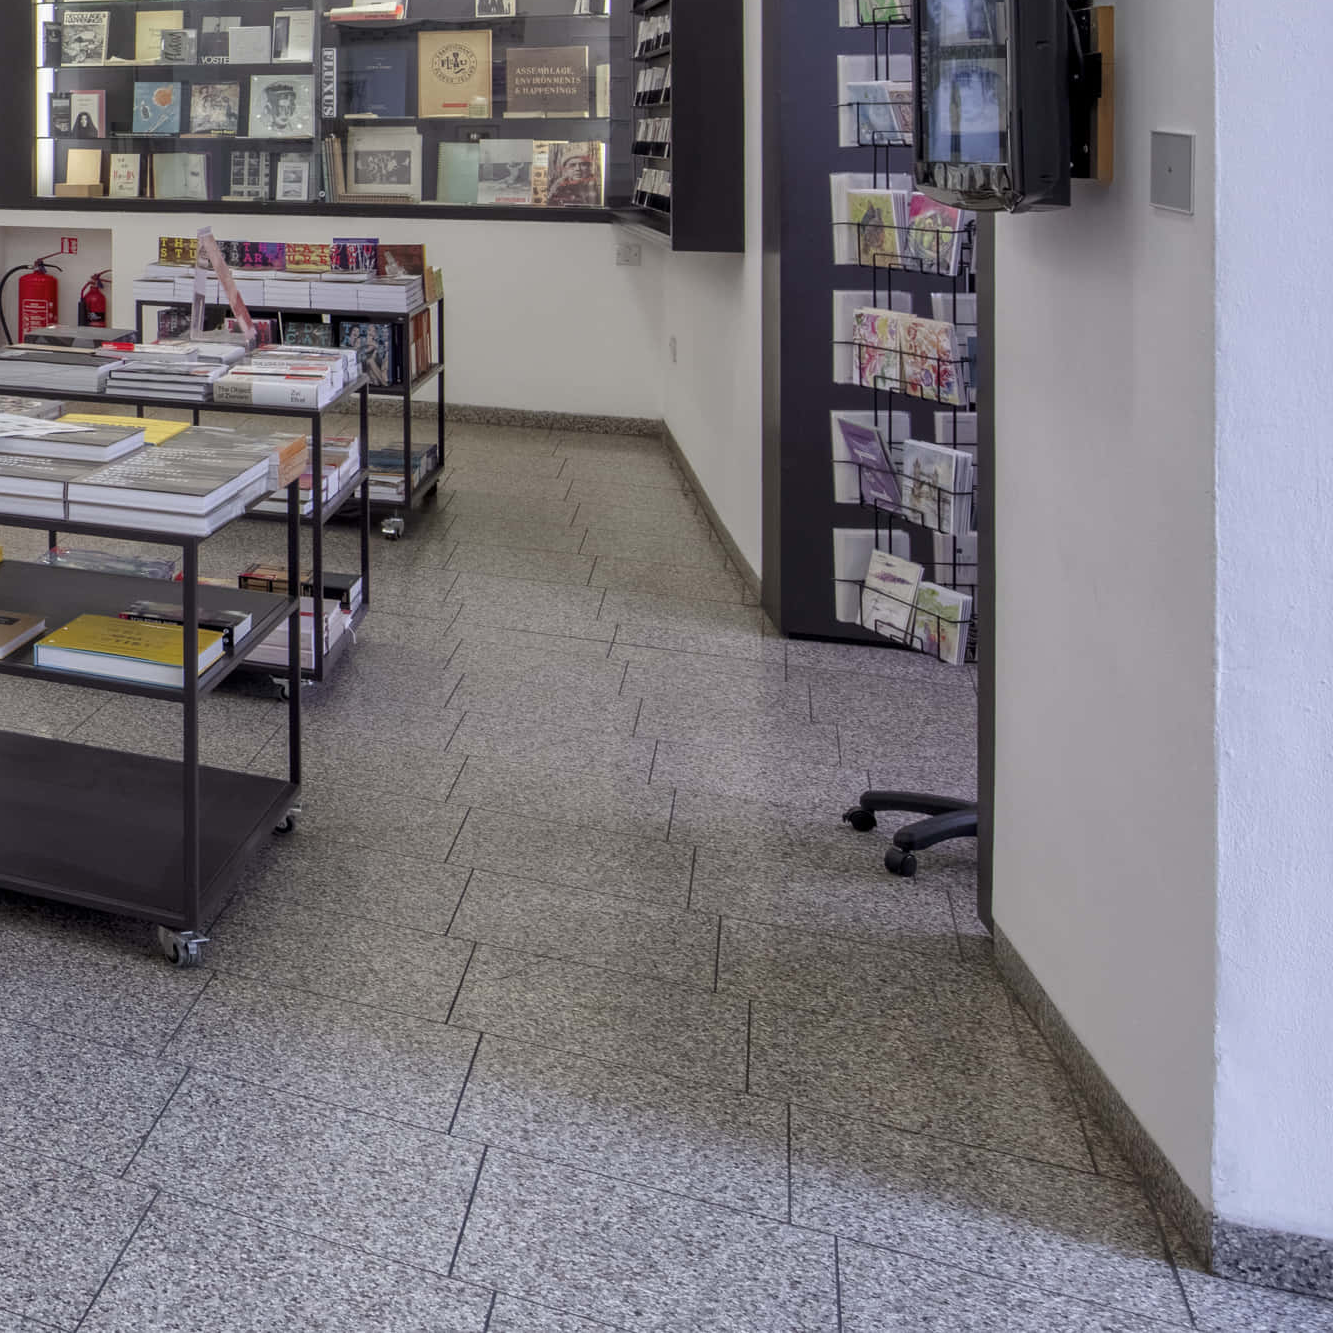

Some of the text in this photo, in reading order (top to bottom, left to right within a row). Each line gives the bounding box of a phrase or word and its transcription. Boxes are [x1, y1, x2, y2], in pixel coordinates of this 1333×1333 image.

[516, 66, 575, 75] ASSEMBLAGE,
[322, 49, 334, 117] FLUXUS
[515, 76, 581, 85] ENVIRONMENTS
[523, 86, 577, 95] HAPPENINGS
[160, 237, 198, 248] THE
[286, 243, 327, 254] NAT
[287, 255, 327, 265] URE
[218, 385, 229, 393] The
